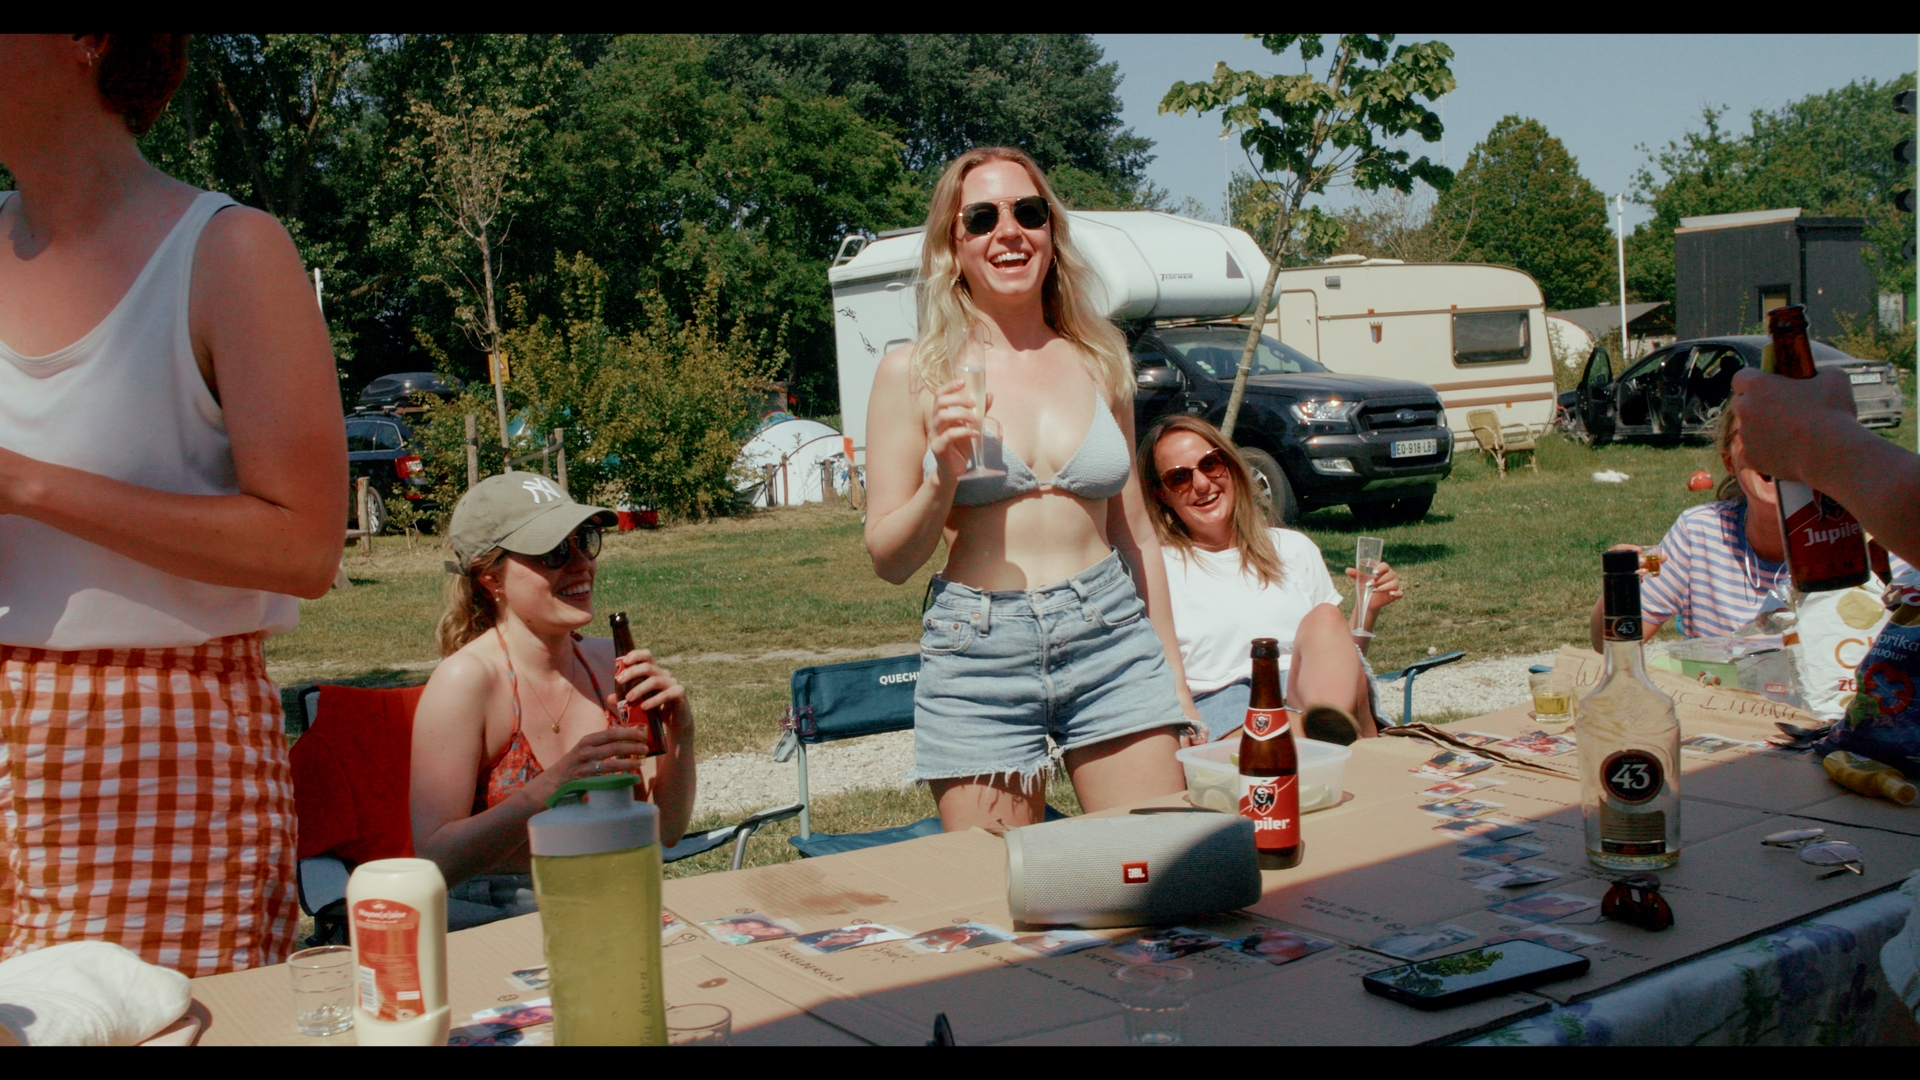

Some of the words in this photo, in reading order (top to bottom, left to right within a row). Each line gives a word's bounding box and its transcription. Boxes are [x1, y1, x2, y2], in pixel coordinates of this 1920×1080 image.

[522, 477, 562, 504] NY
[1803, 521, 1862, 547] Jupile
[1617, 621, 1635, 634] 43
[879, 671, 920, 686] QUECH
[1611, 763, 1651, 790] 43
[1254, 816, 1292, 833] piler
[1127, 867, 1146, 879] JBL
